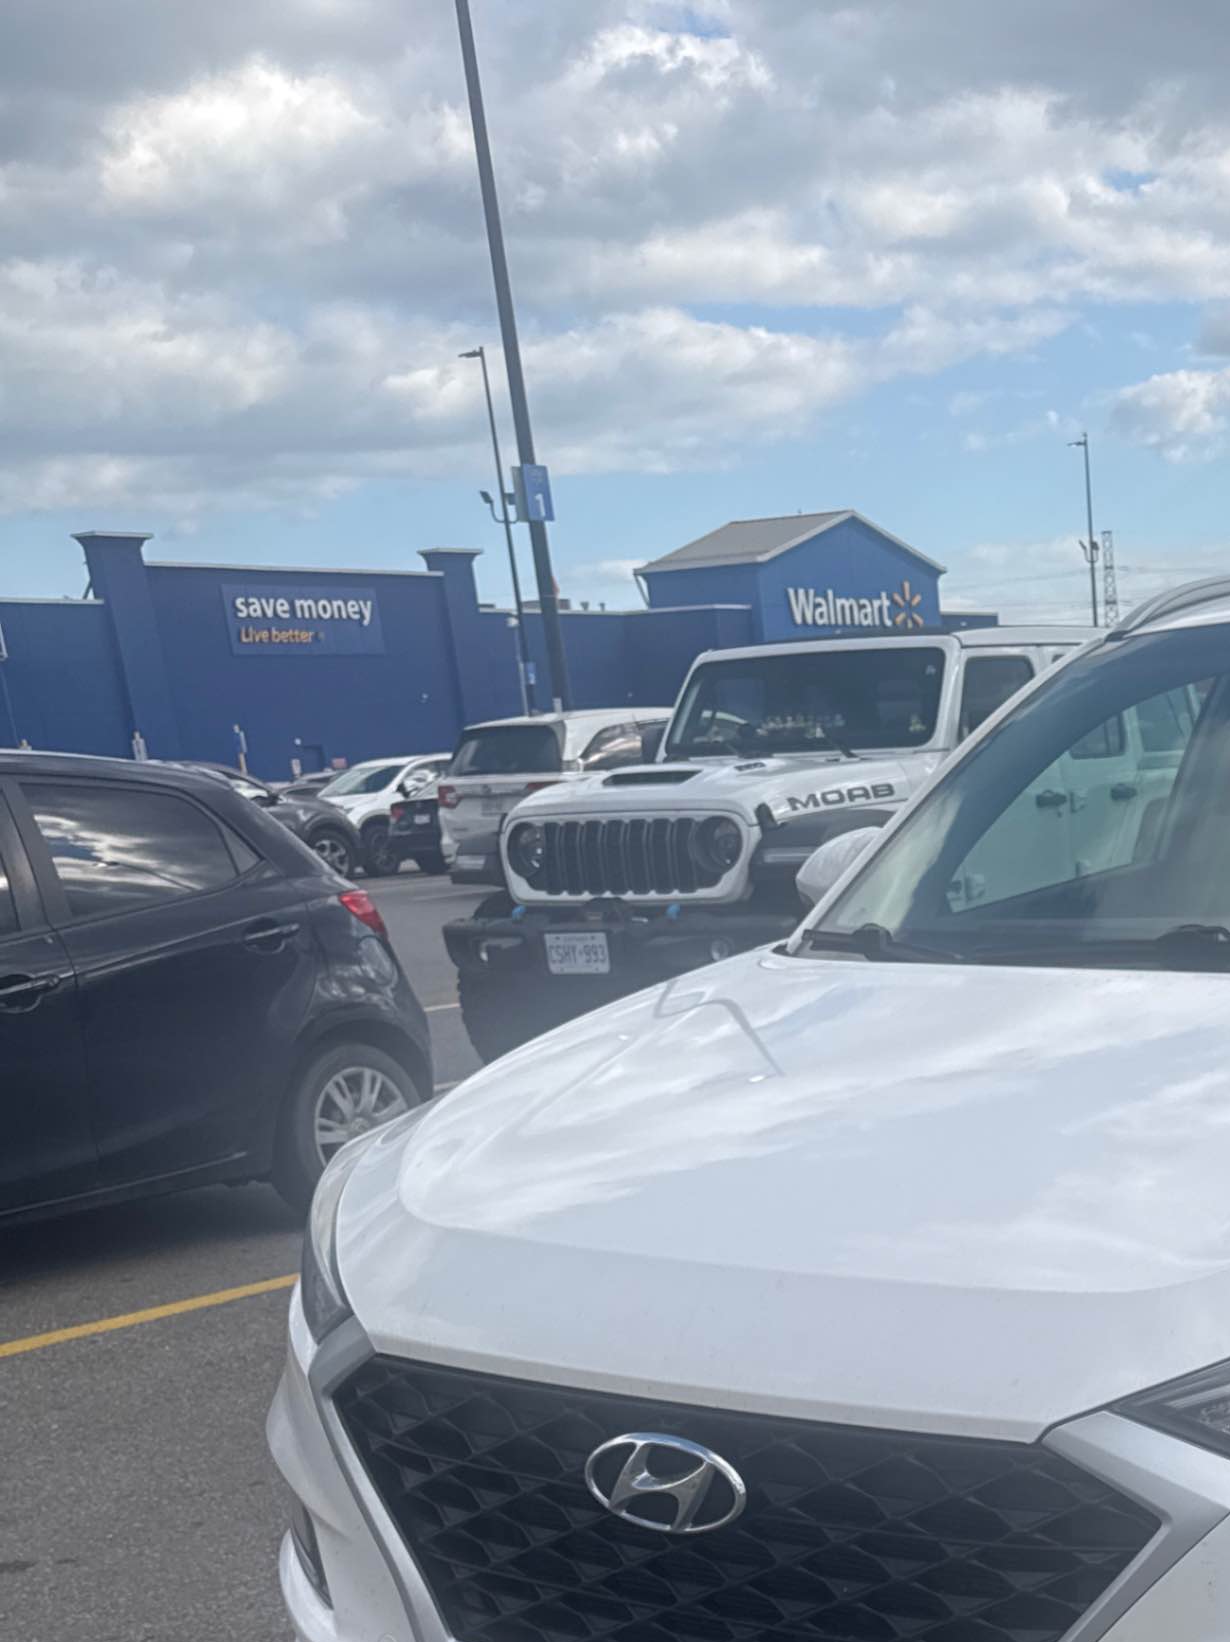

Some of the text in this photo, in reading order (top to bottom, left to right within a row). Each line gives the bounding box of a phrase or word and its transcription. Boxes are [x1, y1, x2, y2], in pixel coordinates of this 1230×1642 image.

[534, 493, 546, 517] 1
[234, 597, 372, 626] save money
[786, 587, 893, 627] Walmart
[239, 627, 315, 643] Live better
[786, 783, 896, 811] MOAB
